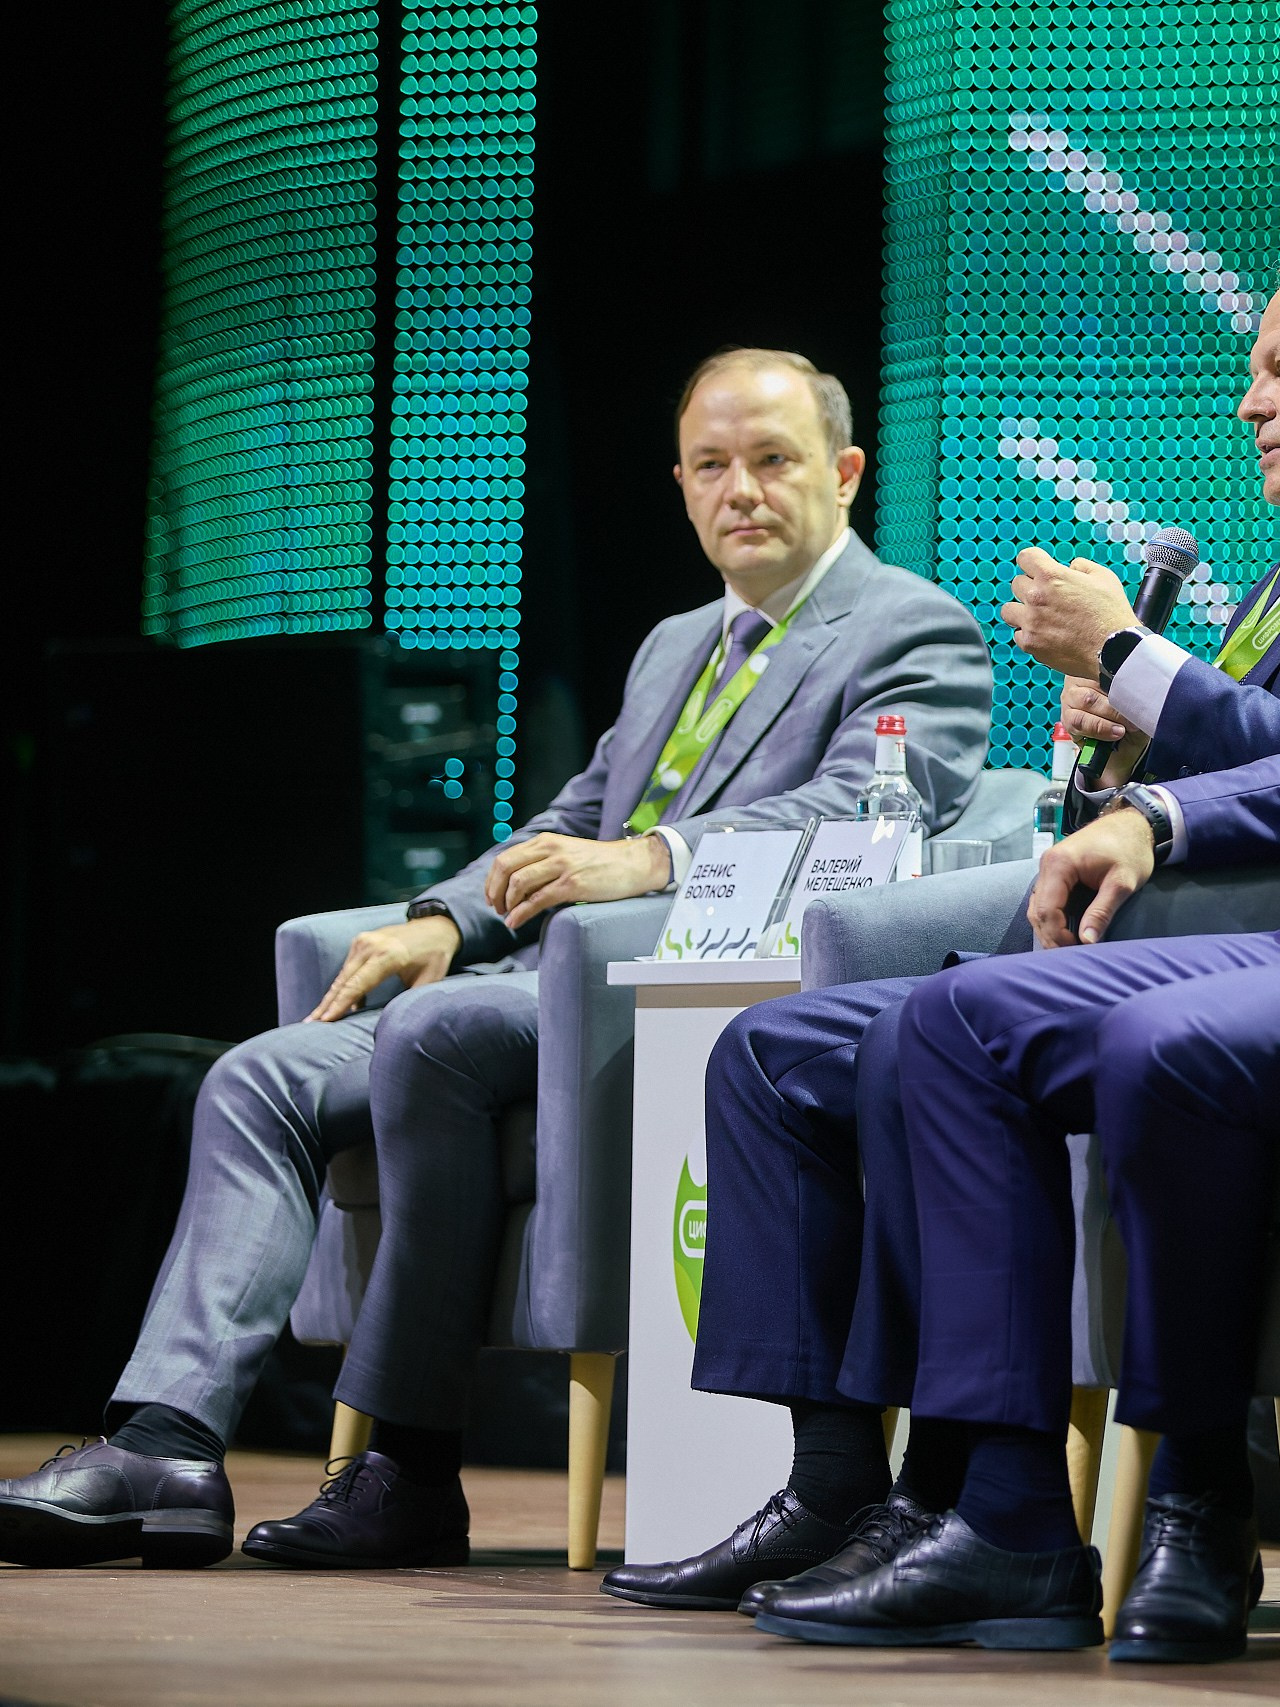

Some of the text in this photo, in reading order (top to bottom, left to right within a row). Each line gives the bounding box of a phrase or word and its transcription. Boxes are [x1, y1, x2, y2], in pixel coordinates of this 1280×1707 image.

[691, 864, 736, 881] ДЕНИС
[811, 855, 863, 874] ВАЛЕРИЙ
[685, 884, 736, 899] ВОЛКОВ
